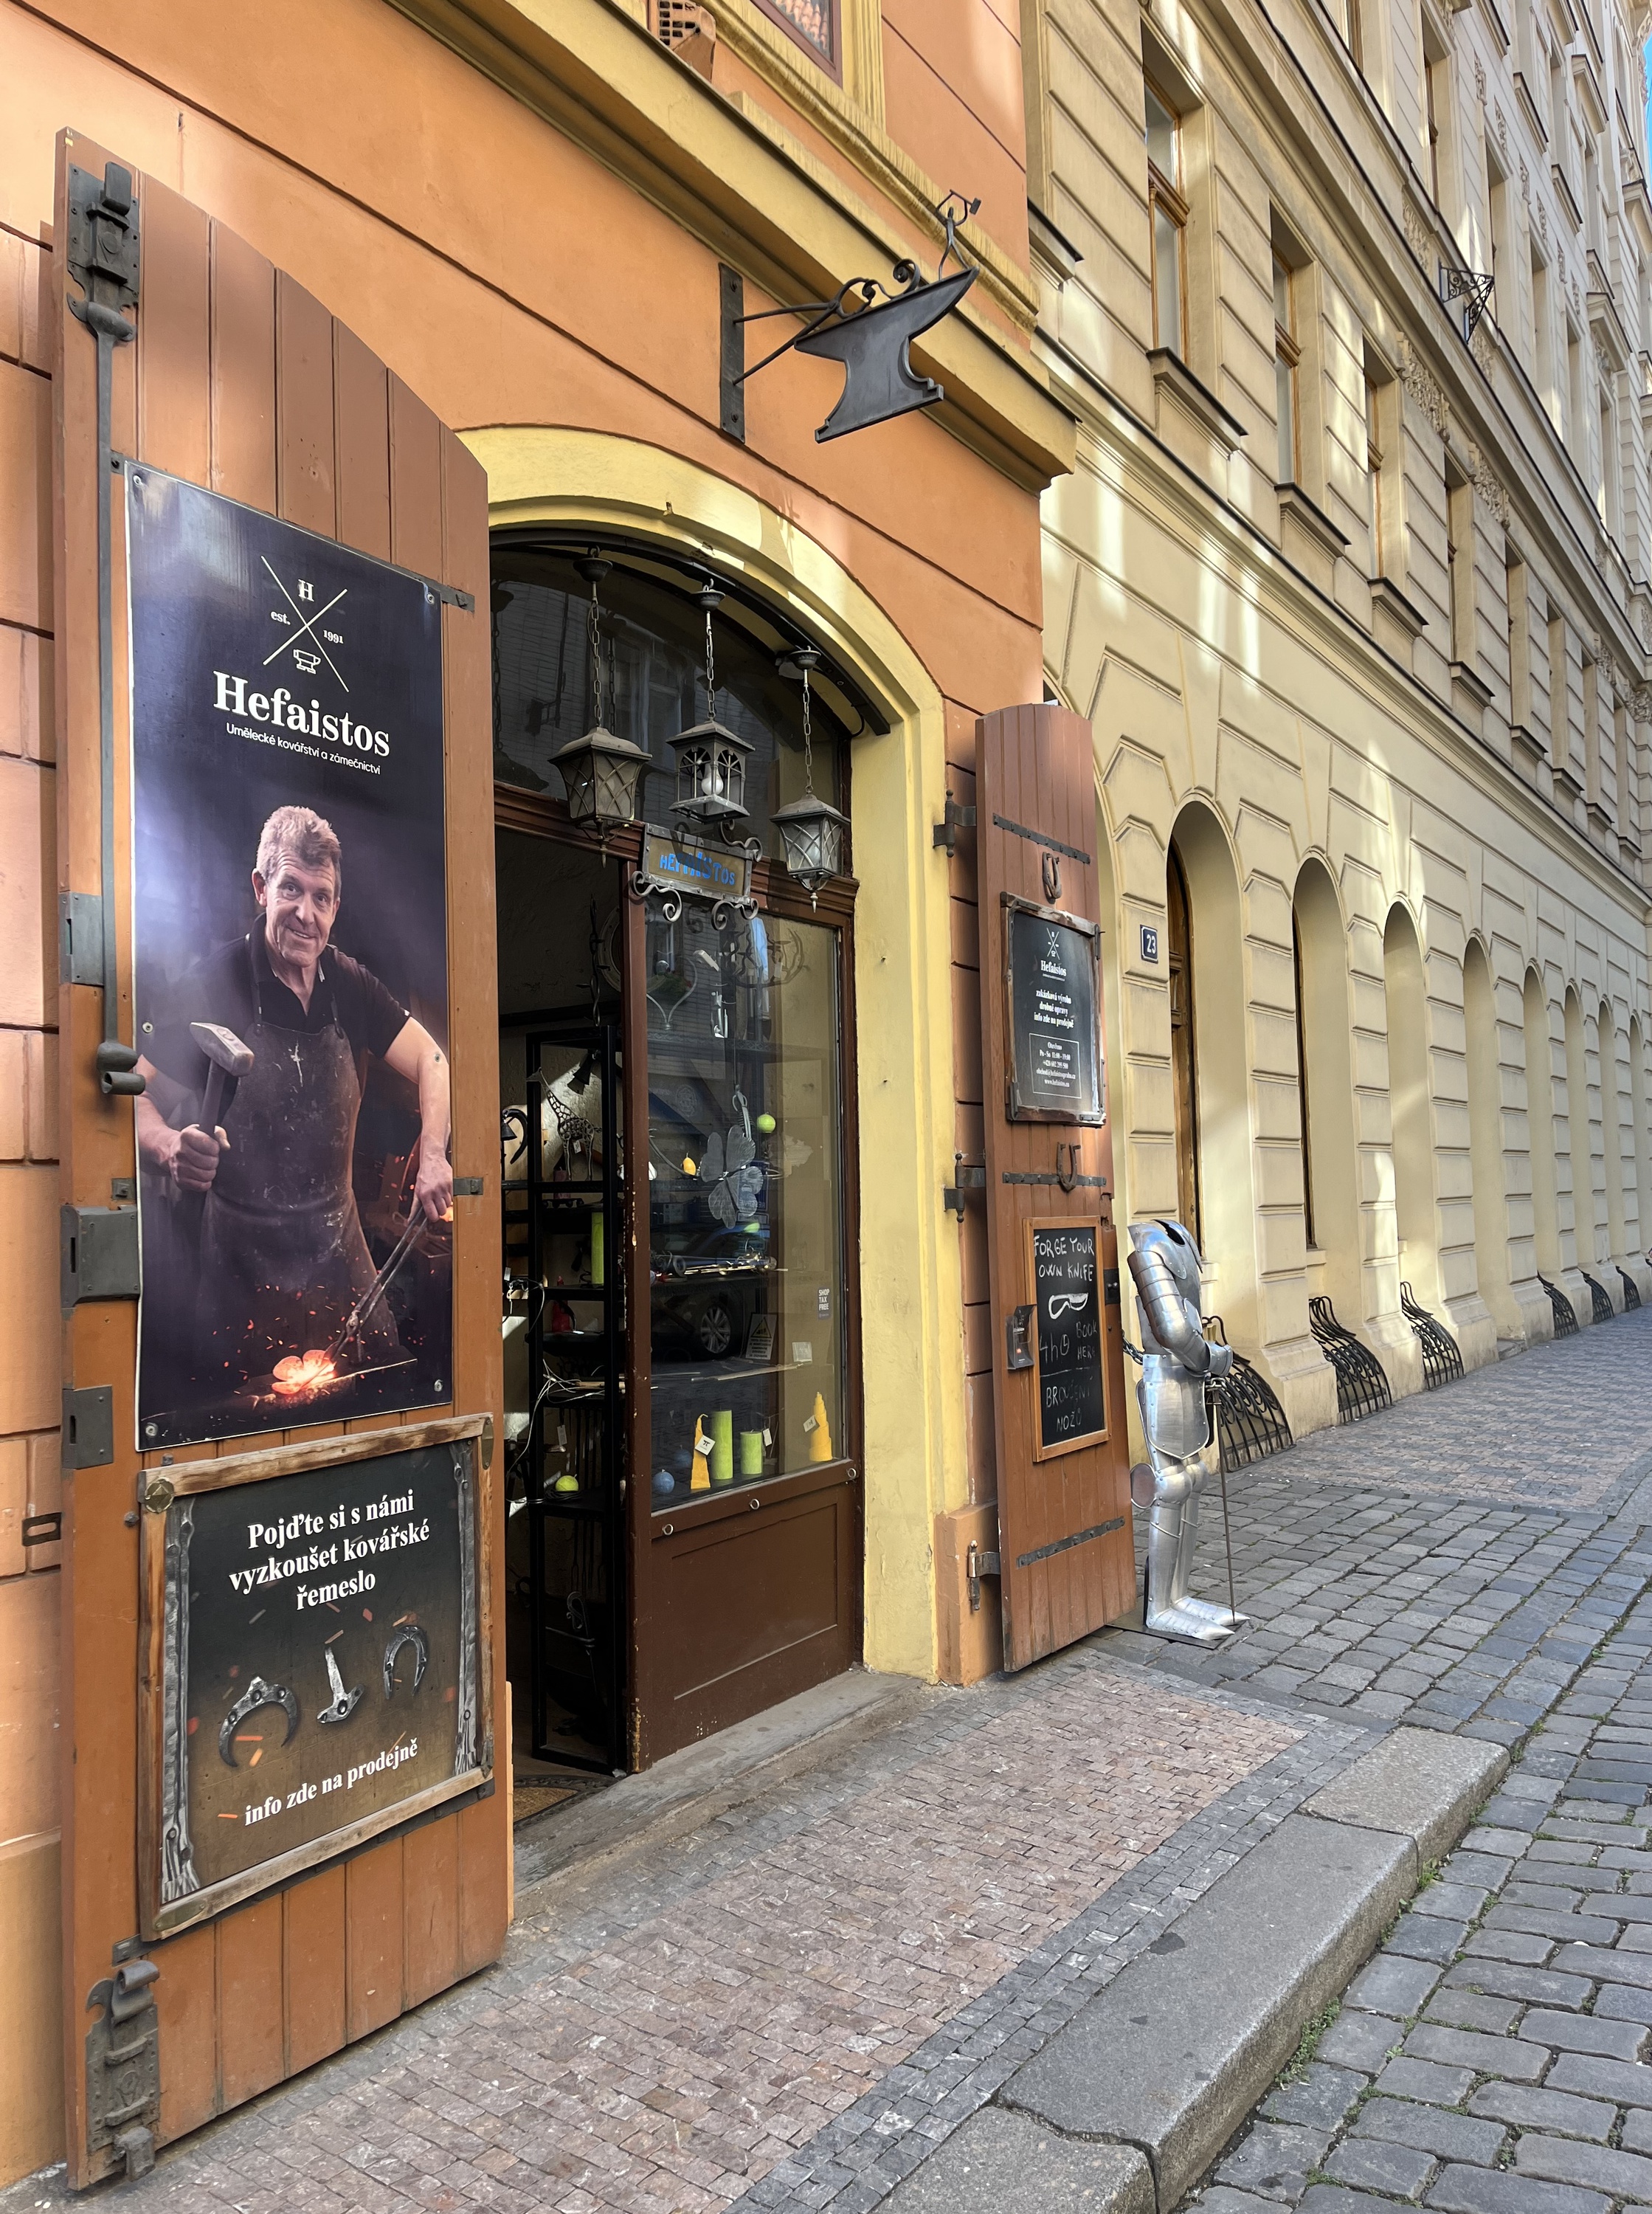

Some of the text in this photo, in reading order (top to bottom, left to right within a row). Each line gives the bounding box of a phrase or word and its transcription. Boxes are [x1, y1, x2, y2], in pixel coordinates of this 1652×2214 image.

[298, 579, 314, 602] H
[270, 611, 344, 644] est. 1991
[213, 670, 390, 758] Hefaistos
[226, 722, 276, 745] Umělecké
[321, 751, 328, 760] a
[660, 852, 736, 886] HEFAISTOS
[1147, 934, 1156, 953] 23
[1040, 959, 1067, 977] Hefaistos
[1034, 1012, 1043, 1022] info
[1057, 1017, 1074, 1029] prodejně
[1039, 1001, 1068, 1017] drobné opravy
[1034, 1235, 1094, 1258] FORGE YOUR
[1039, 1261, 1094, 1281] OWN KNIFE
[1076, 1320, 1097, 1338] BOOK
[1077, 1345, 1096, 1361] HERE
[1056, 1407, 1082, 1432] NOŽŮ
[247, 1489, 415, 1550] Pojďte si s námi
[229, 1518, 430, 1595] vyzkoušet kovářské
[296, 1570, 376, 1610] řemeslo
[244, 1737, 418, 1827] info zde na prodejně
